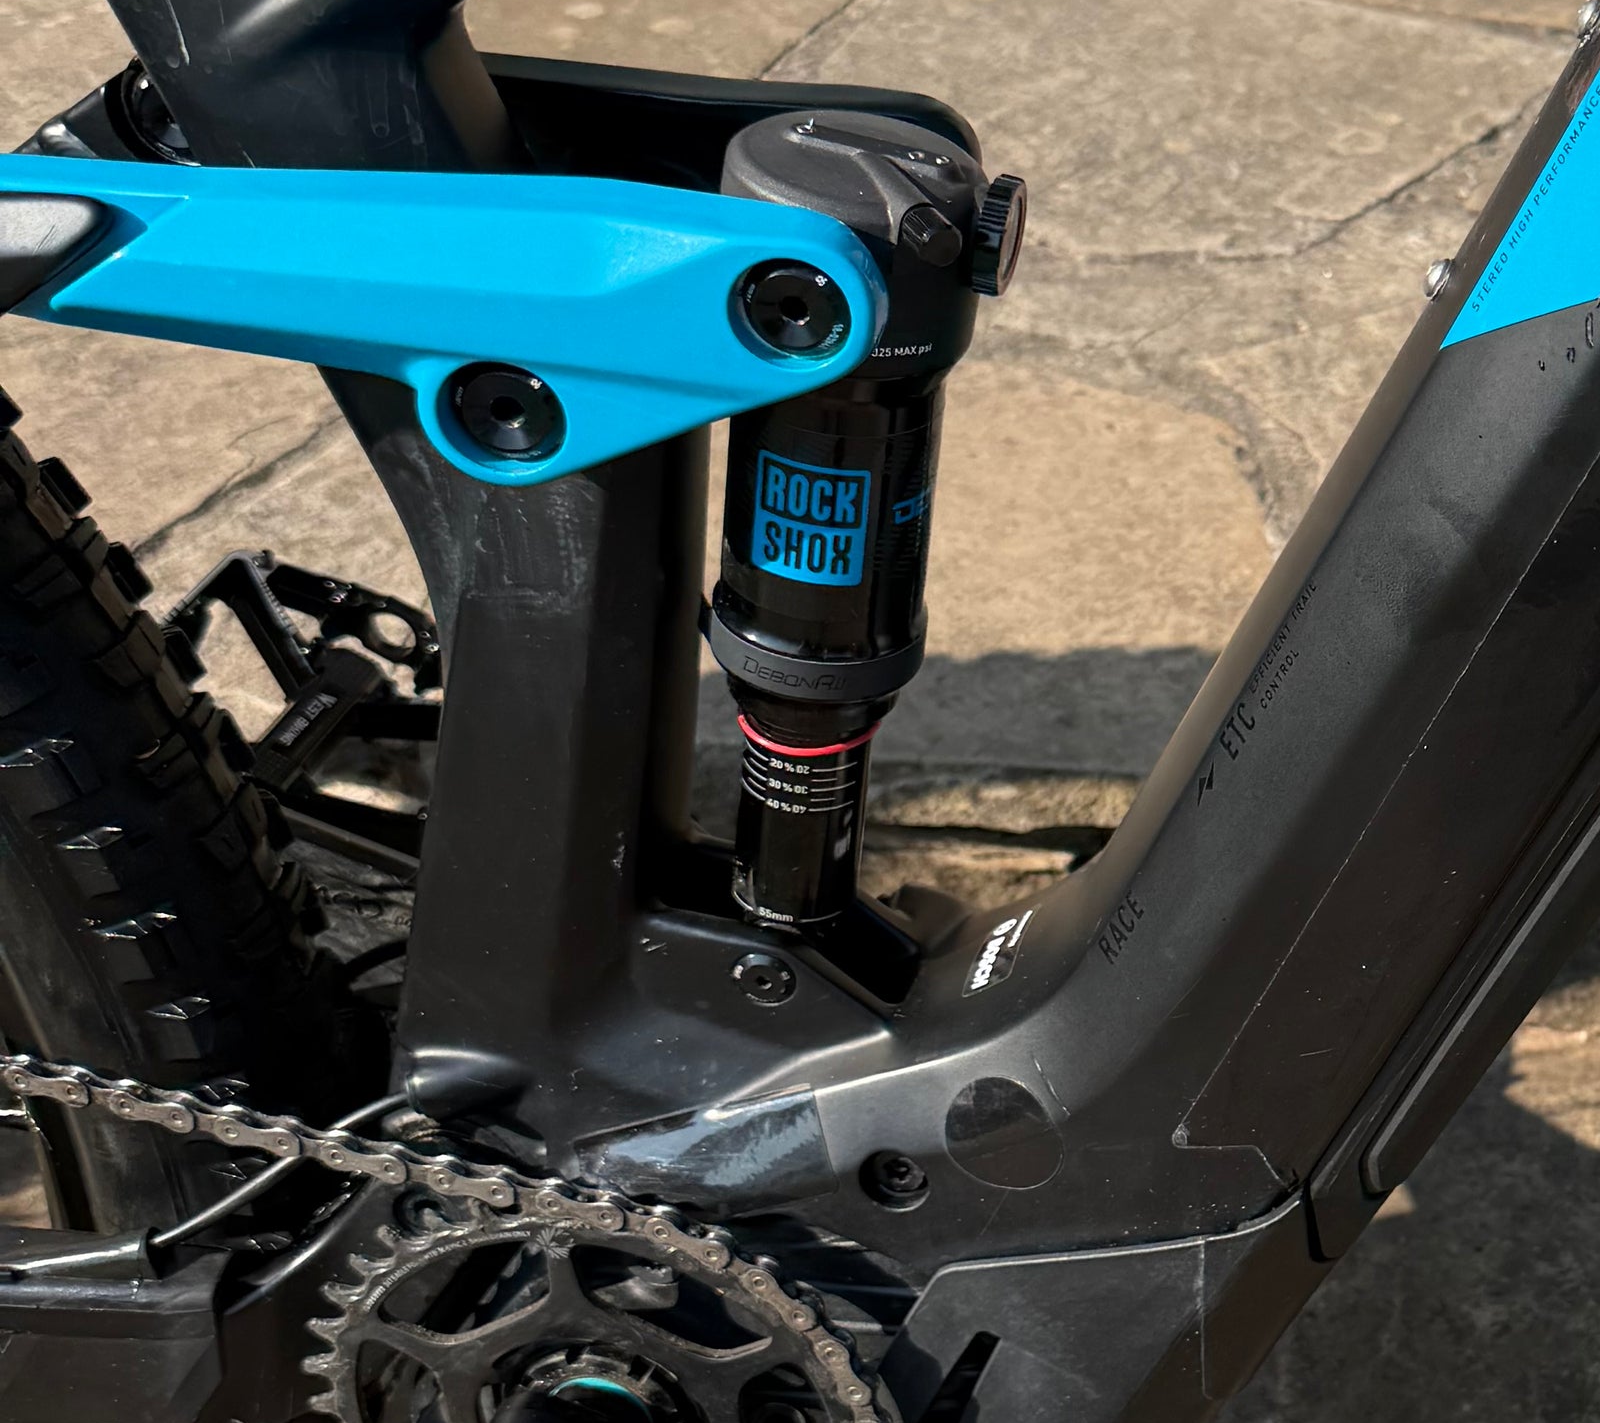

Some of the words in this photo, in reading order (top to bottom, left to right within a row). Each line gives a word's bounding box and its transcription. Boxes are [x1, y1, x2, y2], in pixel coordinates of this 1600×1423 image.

[1471, 252, 1509, 313] STEREO
[1509, 209, 1535, 250] HIGH
[894, 346, 917, 356] MAX
[765, 464, 858, 524] ROCK
[763, 520, 853, 576] SHOX
[1259, 649, 1300, 710] CONTROL
[1219, 702, 1256, 761] ETC
[758, 906, 794, 923] 55mm
[1099, 889, 1145, 965] RACE
